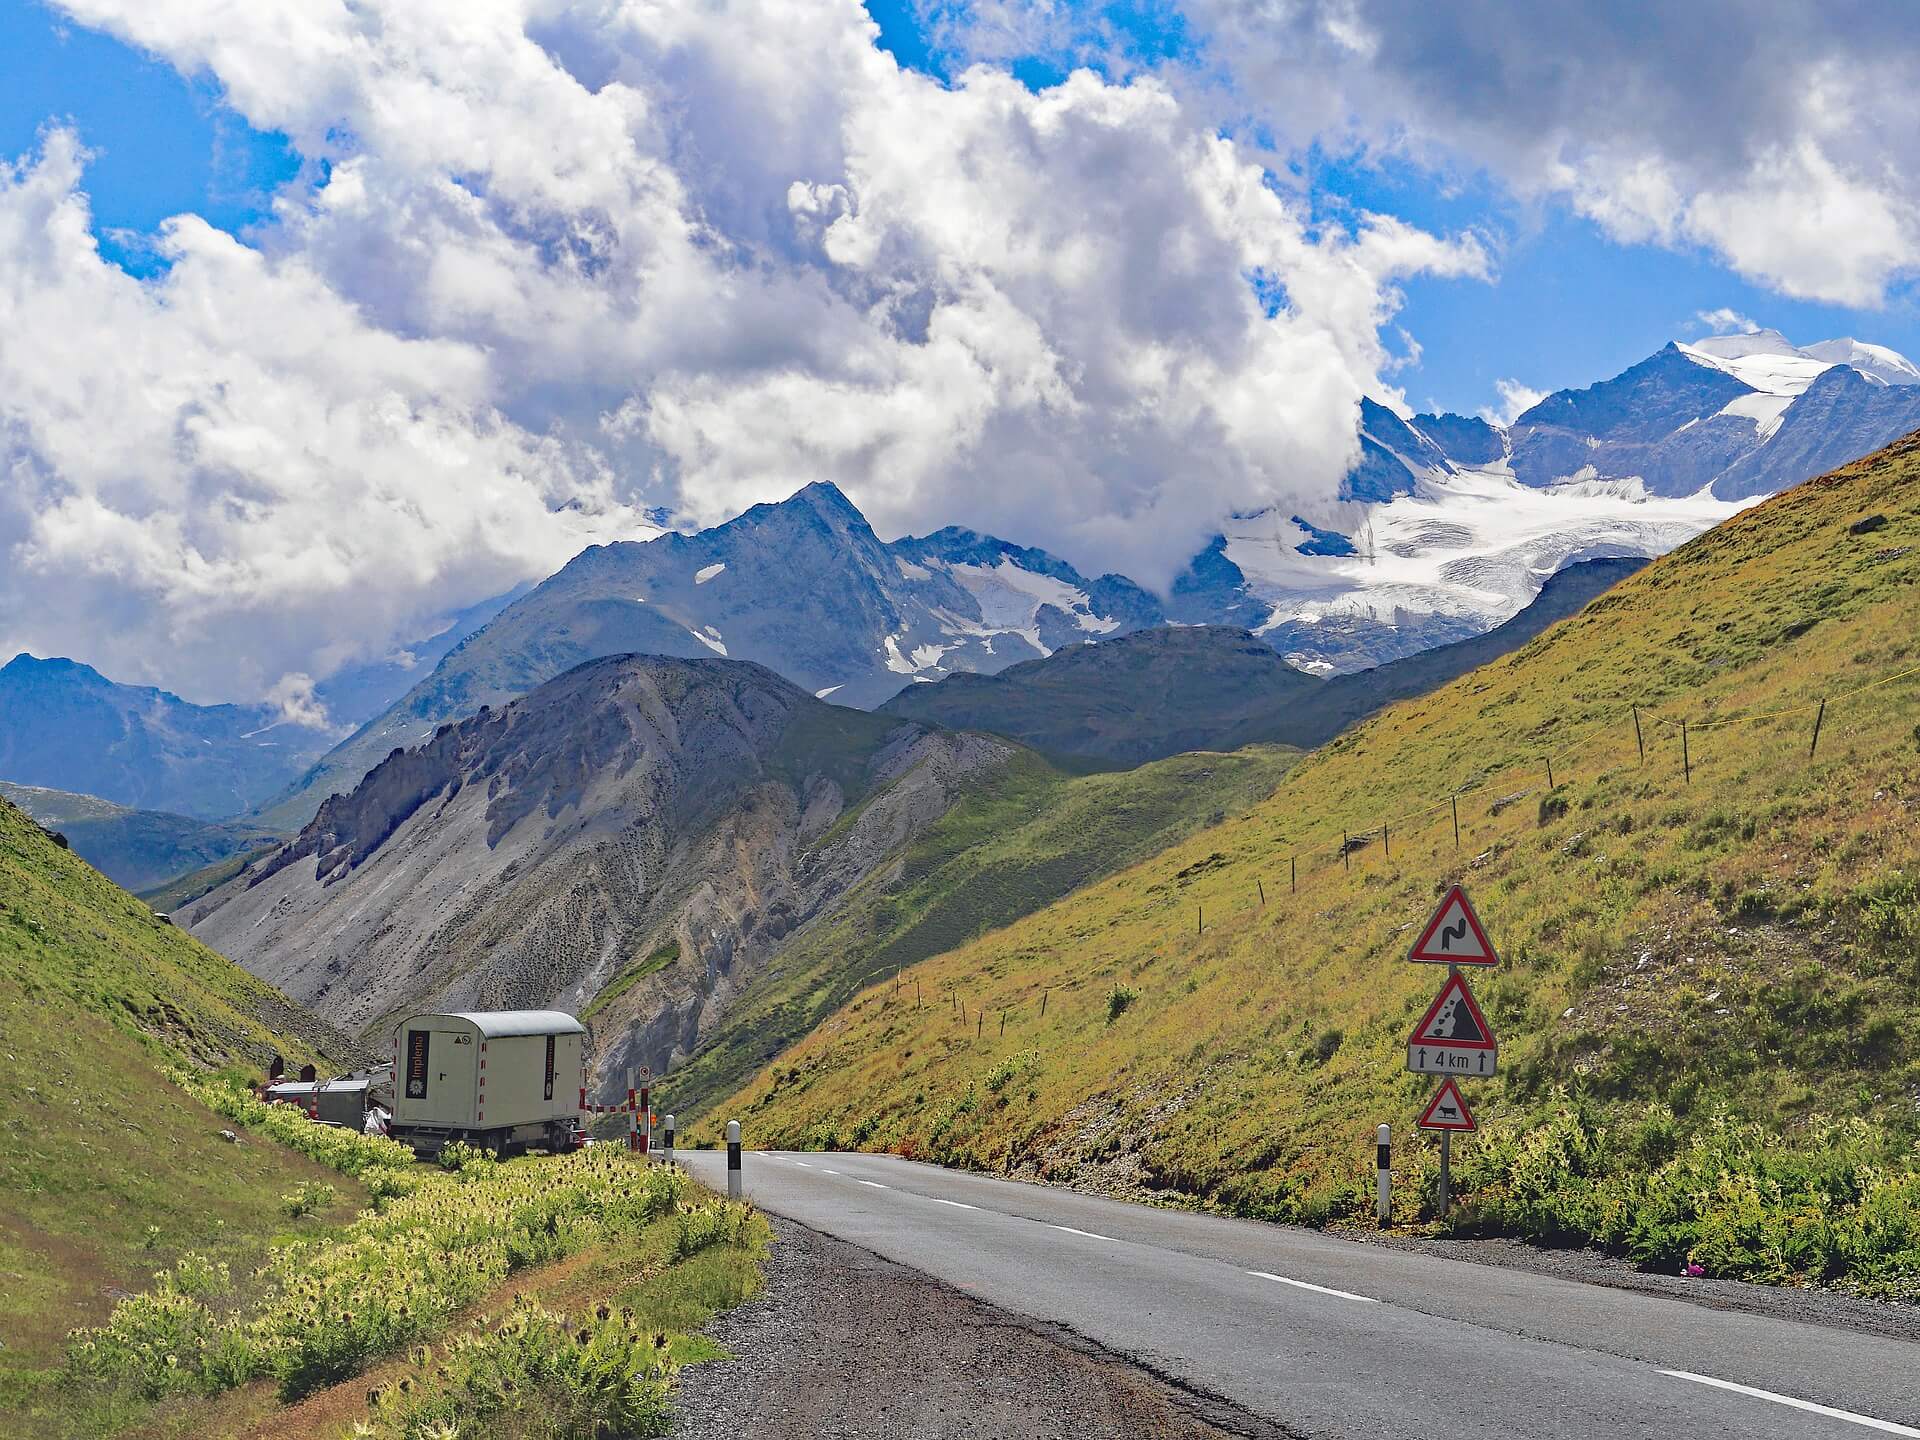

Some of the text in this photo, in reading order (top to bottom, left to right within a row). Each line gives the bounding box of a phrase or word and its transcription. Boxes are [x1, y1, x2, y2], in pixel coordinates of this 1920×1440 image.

[411, 1036, 424, 1078] Implenia
[1435, 1051, 1469, 1069] 4 km
